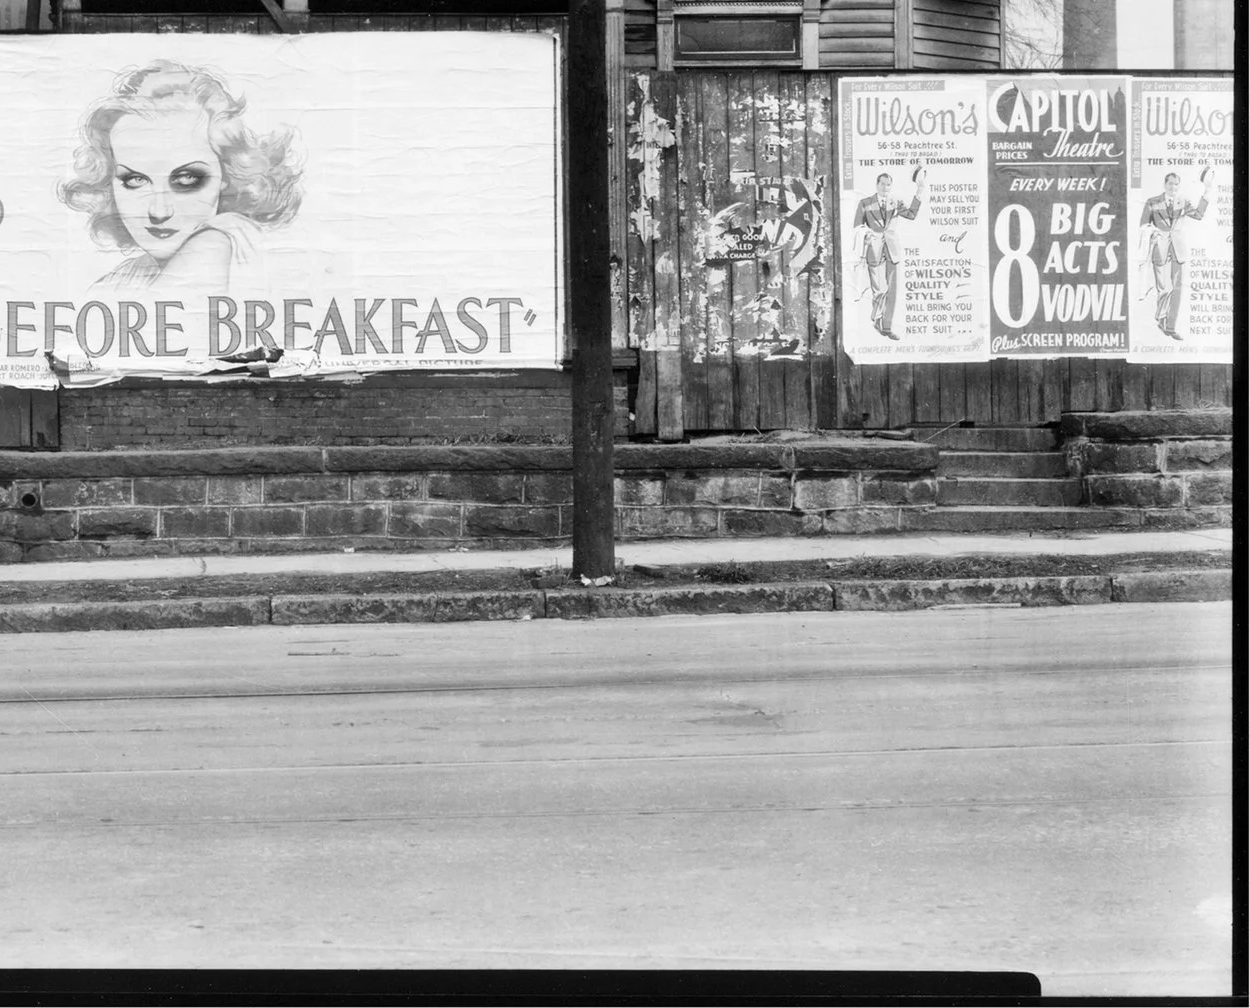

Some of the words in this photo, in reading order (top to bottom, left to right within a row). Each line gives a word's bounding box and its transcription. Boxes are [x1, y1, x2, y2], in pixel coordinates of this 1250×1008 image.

[988, 81, 1117, 134] CAPITOL
[856, 97, 978, 136] Wilson's
[904, 141, 944, 150] Peachtree
[992, 142, 1033, 150] BARGAIN
[1042, 127, 1124, 159] Theatre
[995, 151, 1028, 160] PRICES
[879, 158, 905, 166] STORE
[925, 157, 974, 165] TOMORROW
[1148, 158, 1162, 166] THE
[1167, 158, 1193, 166] STORE
[930, 184, 947, 192] THIS
[949, 183, 979, 192] POSTER
[1009, 178, 1053, 192] EVERY
[929, 195, 947, 204] MAY
[947, 195, 965, 203] SELL
[964, 194, 980, 203] YOU
[930, 206, 952, 215] YOUR
[954, 206, 976, 214] FIRST
[929, 217, 959, 226] WILSON
[961, 217, 979, 225] SUIT
[1050, 202, 1116, 235] BIG
[939, 230, 968, 254] and
[904, 248, 920, 256] THE
[1190, 248, 1206, 256] THE
[1043, 241, 1120, 274] ACTS
[904, 258, 972, 267] SATISFACTION
[992, 203, 1040, 329] 8
[904, 270, 915, 279] OF
[915, 266, 972, 279] WILSON'S
[905, 280, 951, 292] QUALITY
[905, 292, 944, 301] STYLE
[1190, 293, 1229, 302] STYLE
[905, 303, 925, 312] WILL
[927, 303, 952, 312] BRING
[955, 303, 973, 311] YOU
[1040, 283, 1127, 323] VODVIL
[1190, 304, 1209, 313] WILL
[905, 314, 929, 323] BACK
[932, 314, 948, 322] FOR
[949, 314, 973, 322] YOUR
[1189, 315, 1213, 324] BACK
[905, 325, 928, 334] NEXT
[932, 325, 954, 334] SUIT
[1189, 326, 1211, 335] NEXT
[991, 335, 1021, 353] Plus
[1021, 333, 1063, 347] SCREEN
[1066, 333, 1125, 347] PROGRAM!
[10, 364, 41, 373] ROMERO
[8, 372, 36, 381] ROACH
